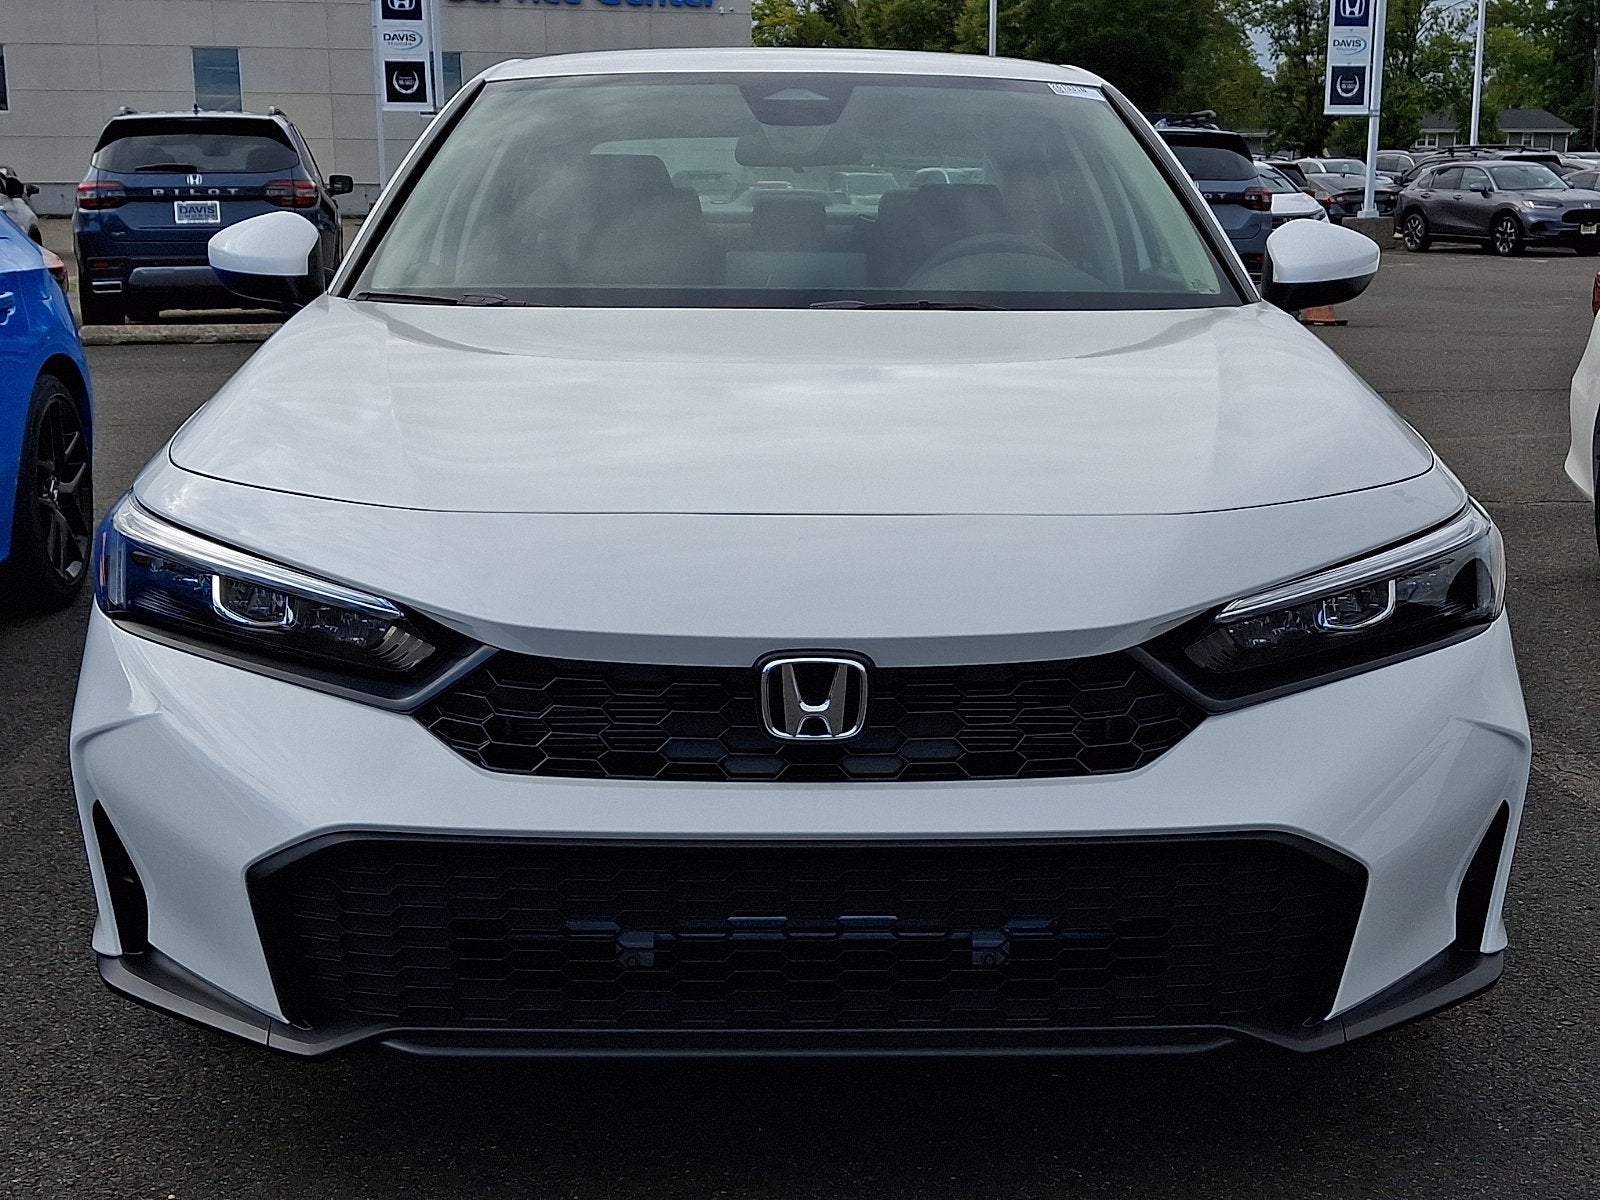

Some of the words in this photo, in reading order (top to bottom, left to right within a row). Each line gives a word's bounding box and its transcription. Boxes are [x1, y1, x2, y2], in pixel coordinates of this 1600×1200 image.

[383, 33, 416, 42] DAVIS
[1333, 39, 1362, 47] DAVIS
[152, 188, 239, 196] PILOT
[179, 205, 215, 214] DAVIS
